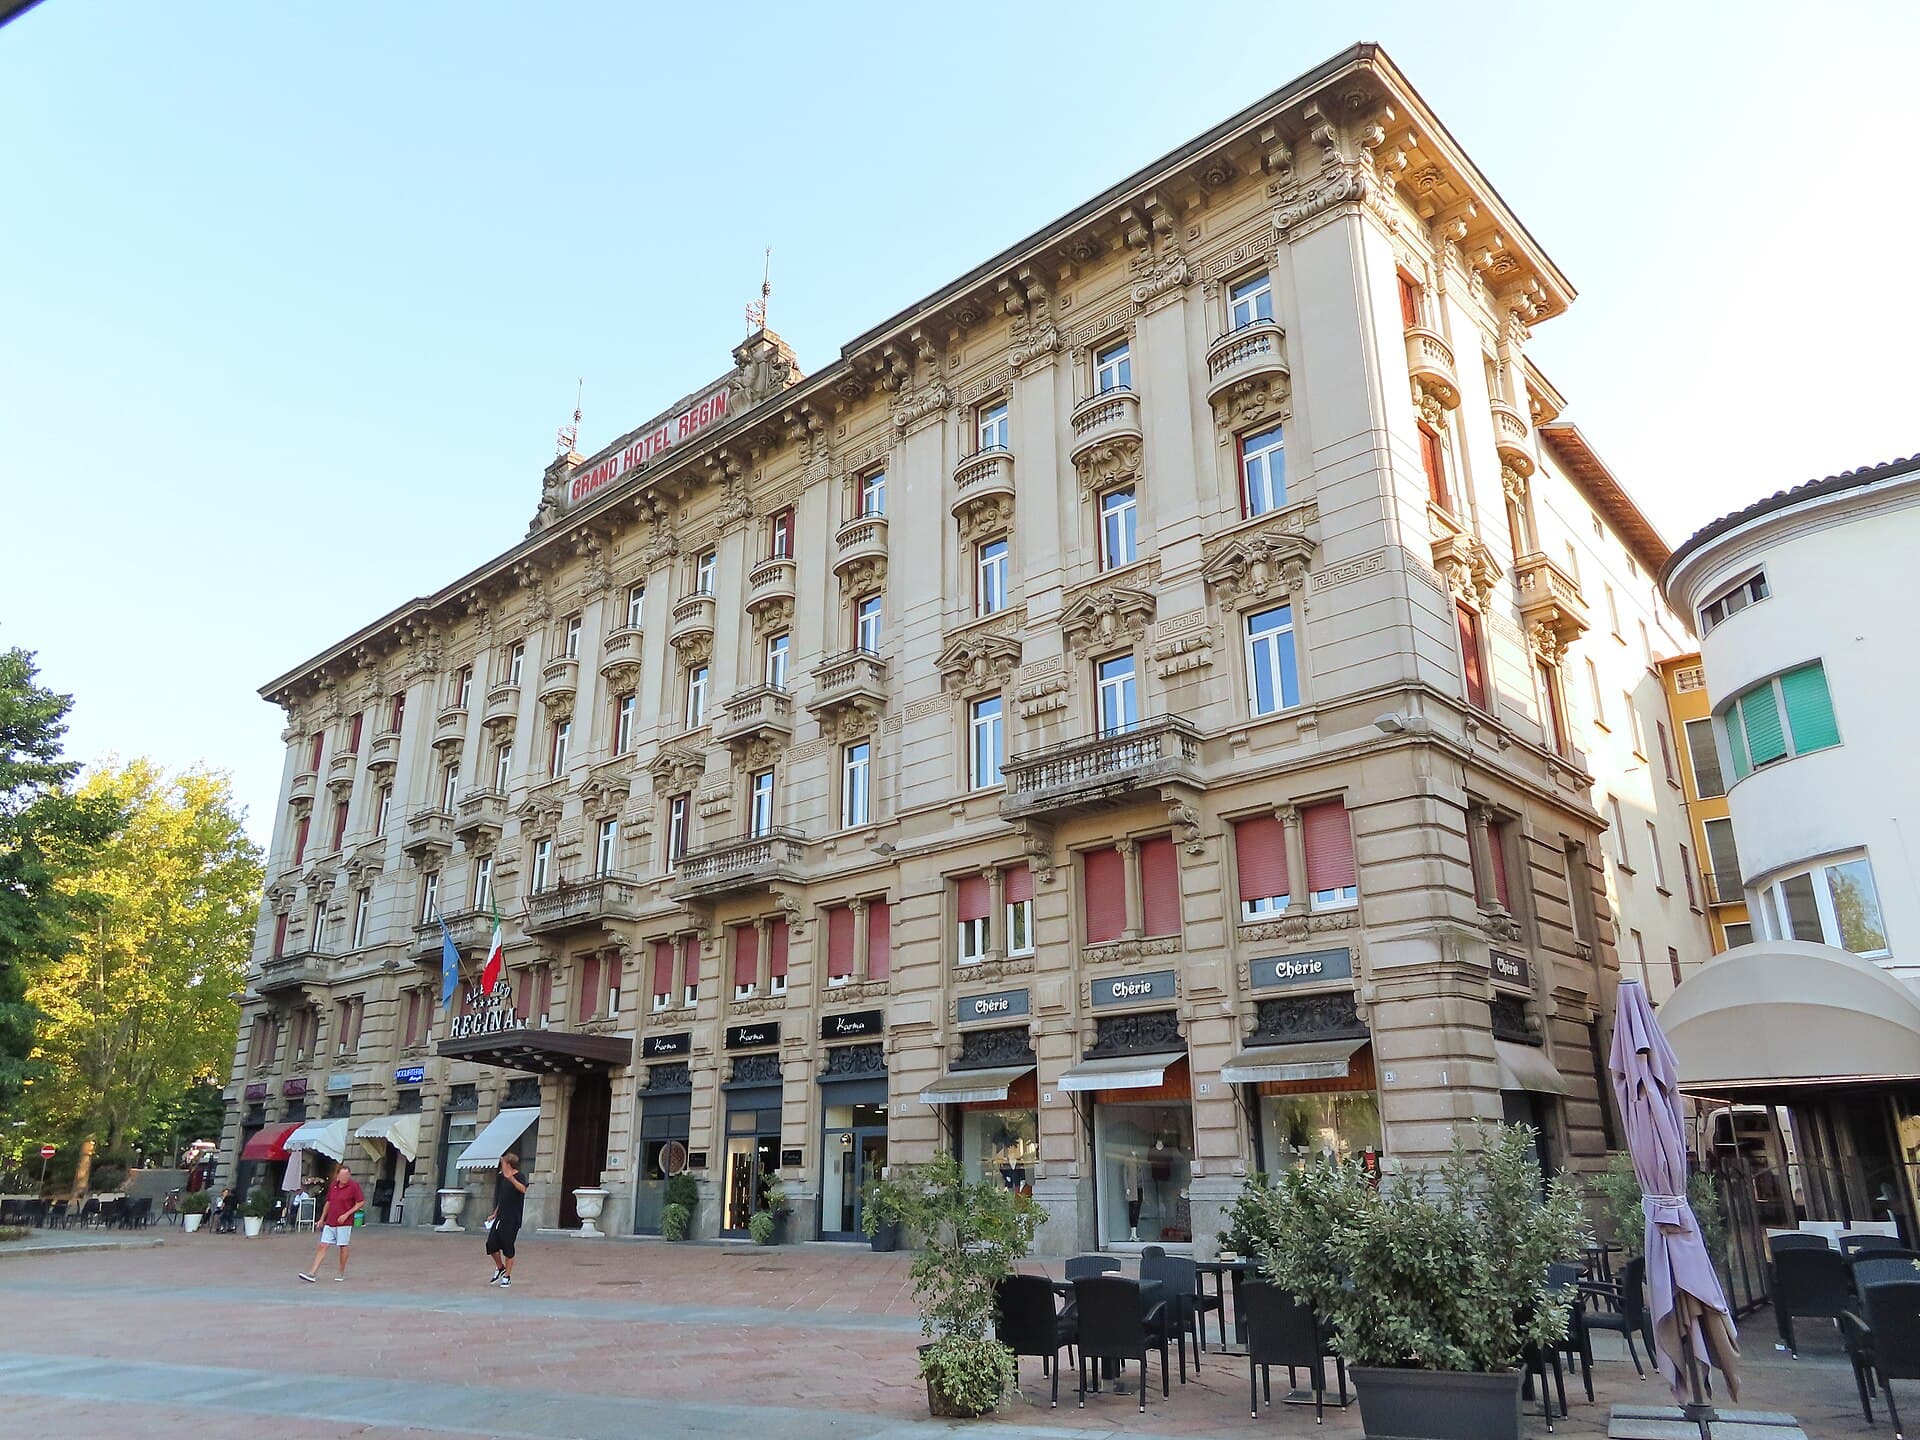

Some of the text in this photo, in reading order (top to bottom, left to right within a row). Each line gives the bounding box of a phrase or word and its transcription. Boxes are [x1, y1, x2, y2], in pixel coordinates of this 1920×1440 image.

[572, 457, 619, 500] GRAND
[623, 425, 672, 471] HOTEL
[1275, 960, 1323, 979] Chérie
[1496, 957, 1519, 976] Chérie
[1112, 981, 1152, 998] Chérie
[975, 998, 1009, 1015] Chérie
[450, 1007, 515, 1037] REGINA
[836, 1017, 865, 1032] Karma
[739, 1028, 764, 1042] Karma
